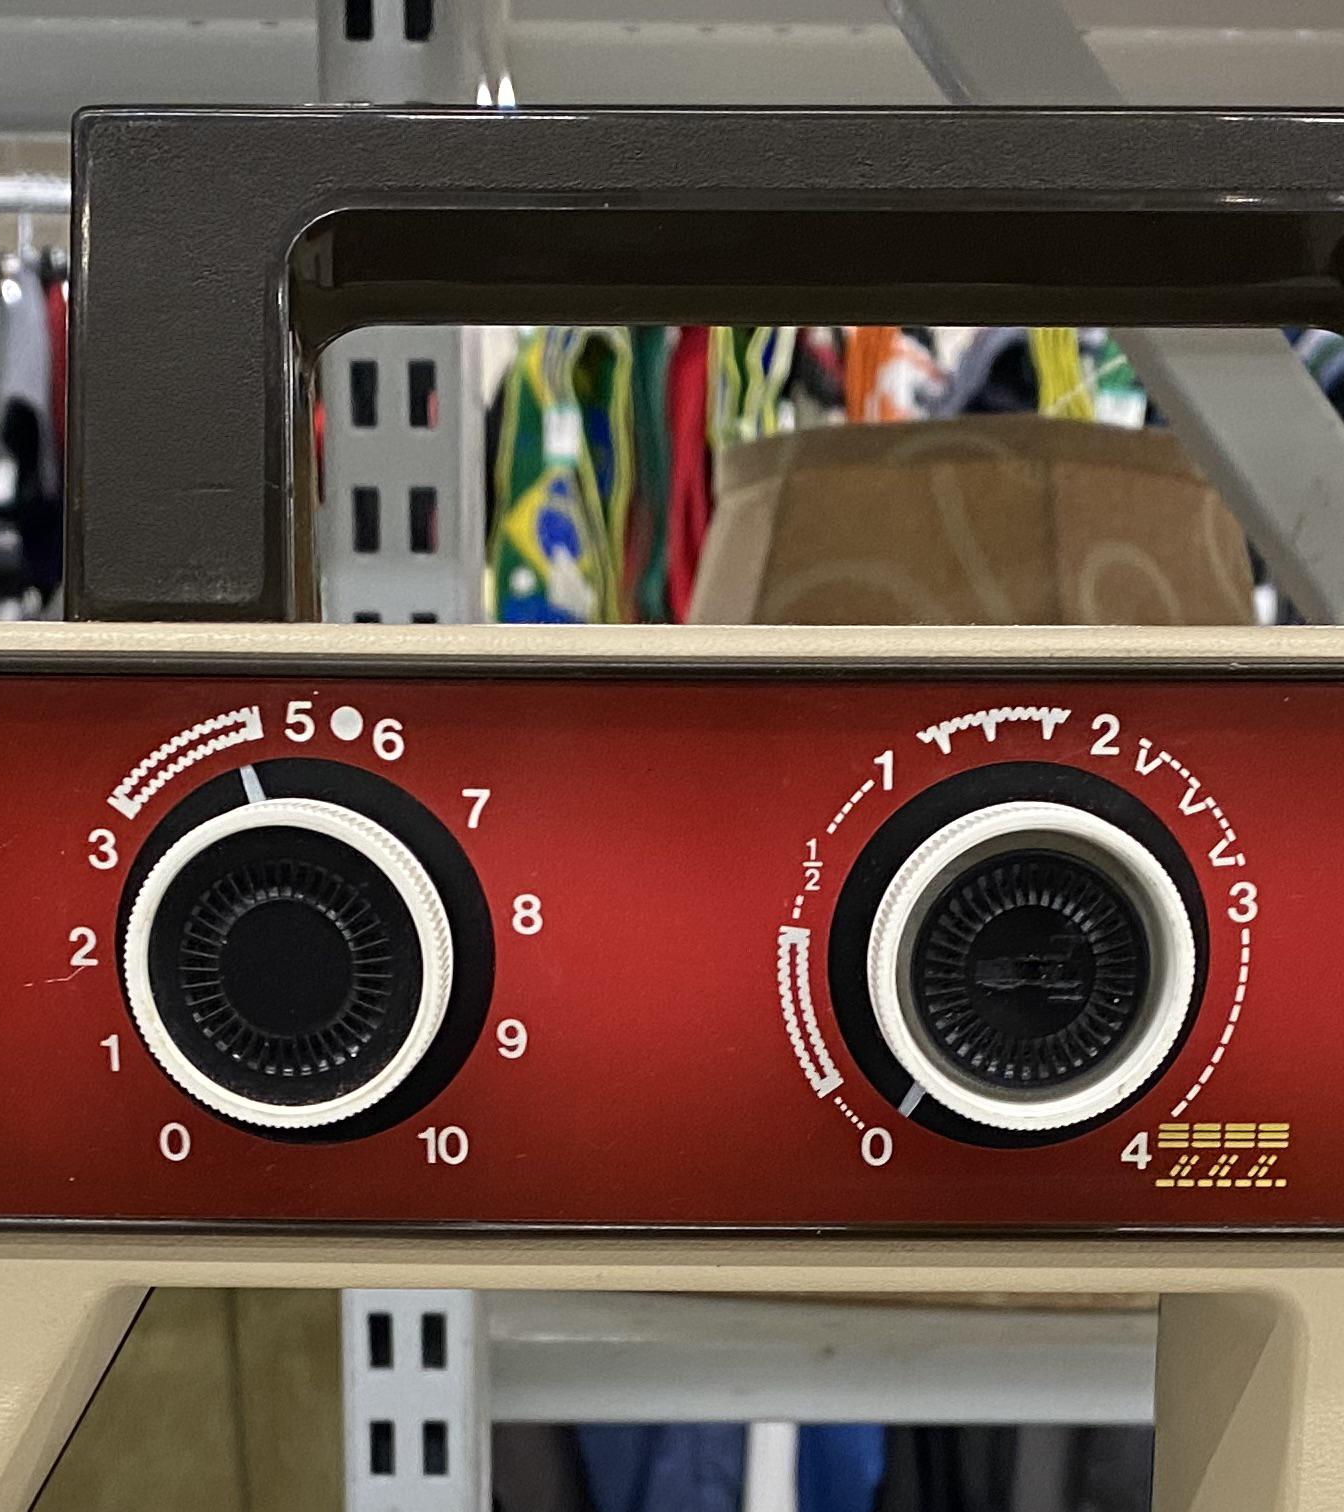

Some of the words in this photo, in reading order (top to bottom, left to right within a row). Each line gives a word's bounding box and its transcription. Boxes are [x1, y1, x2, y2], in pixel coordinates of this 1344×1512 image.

[284, 700, 316, 743] 5
[372, 718, 405, 761] 6
[1089, 713, 1120, 756] 2
[873, 750, 894, 791] 1
[461, 788, 491, 829] 7
[88, 828, 119, 870] 3
[511, 893, 544, 936] 8
[1227, 881, 1259, 924] 3
[68, 926, 99, 967] 2
[100, 1034, 120, 1073] 1
[496, 1018, 528, 1059] 9
[159, 1122, 191, 1162] 0
[417, 1125, 470, 1165] 10
[861, 1127, 893, 1167] 0
[1120, 1131, 1153, 1170] 4
